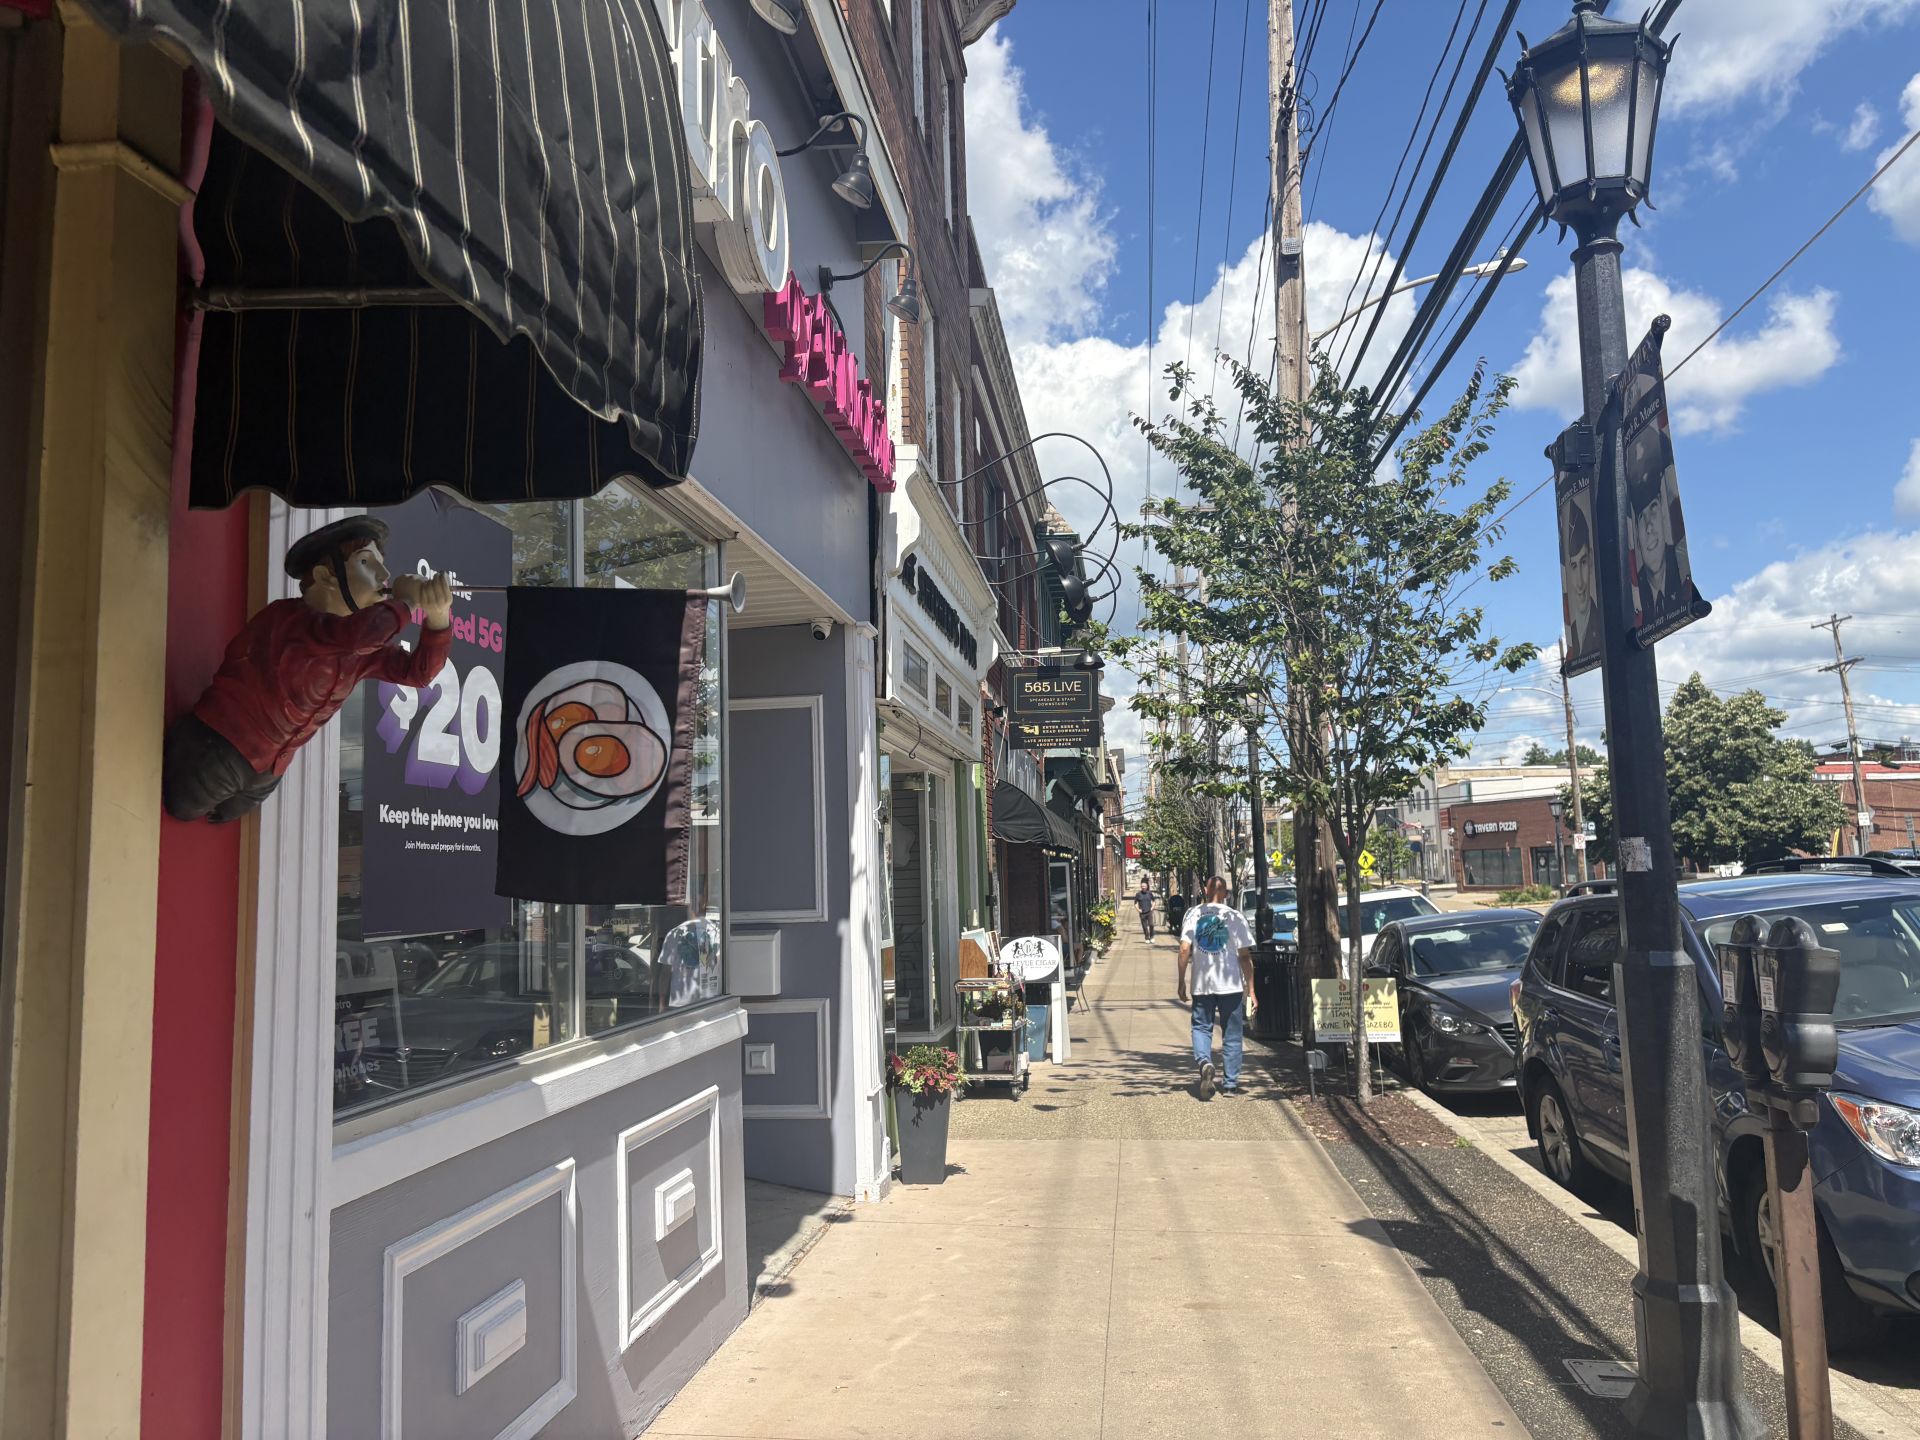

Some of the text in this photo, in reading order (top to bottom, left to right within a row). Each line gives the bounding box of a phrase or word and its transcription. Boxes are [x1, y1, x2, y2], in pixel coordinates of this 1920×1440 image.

[655, 0, 790, 294] tro
[1639, 398, 1660, 423] Moore
[479, 616, 503, 653] 5G
[1024, 680, 1082, 693] 565 LIVE
[389, 645, 502, 774] $20
[379, 803, 410, 829] Keep
[411, 806, 429, 826] the
[430, 808, 462, 831] phone
[463, 817, 481, 833] you
[1474, 821, 1518, 834] TAVERN PIZZA
[404, 840, 416, 849] Join
[415, 841, 430, 850] Metro
[430, 842, 440, 850] and
[439, 843, 455, 853] prepay
